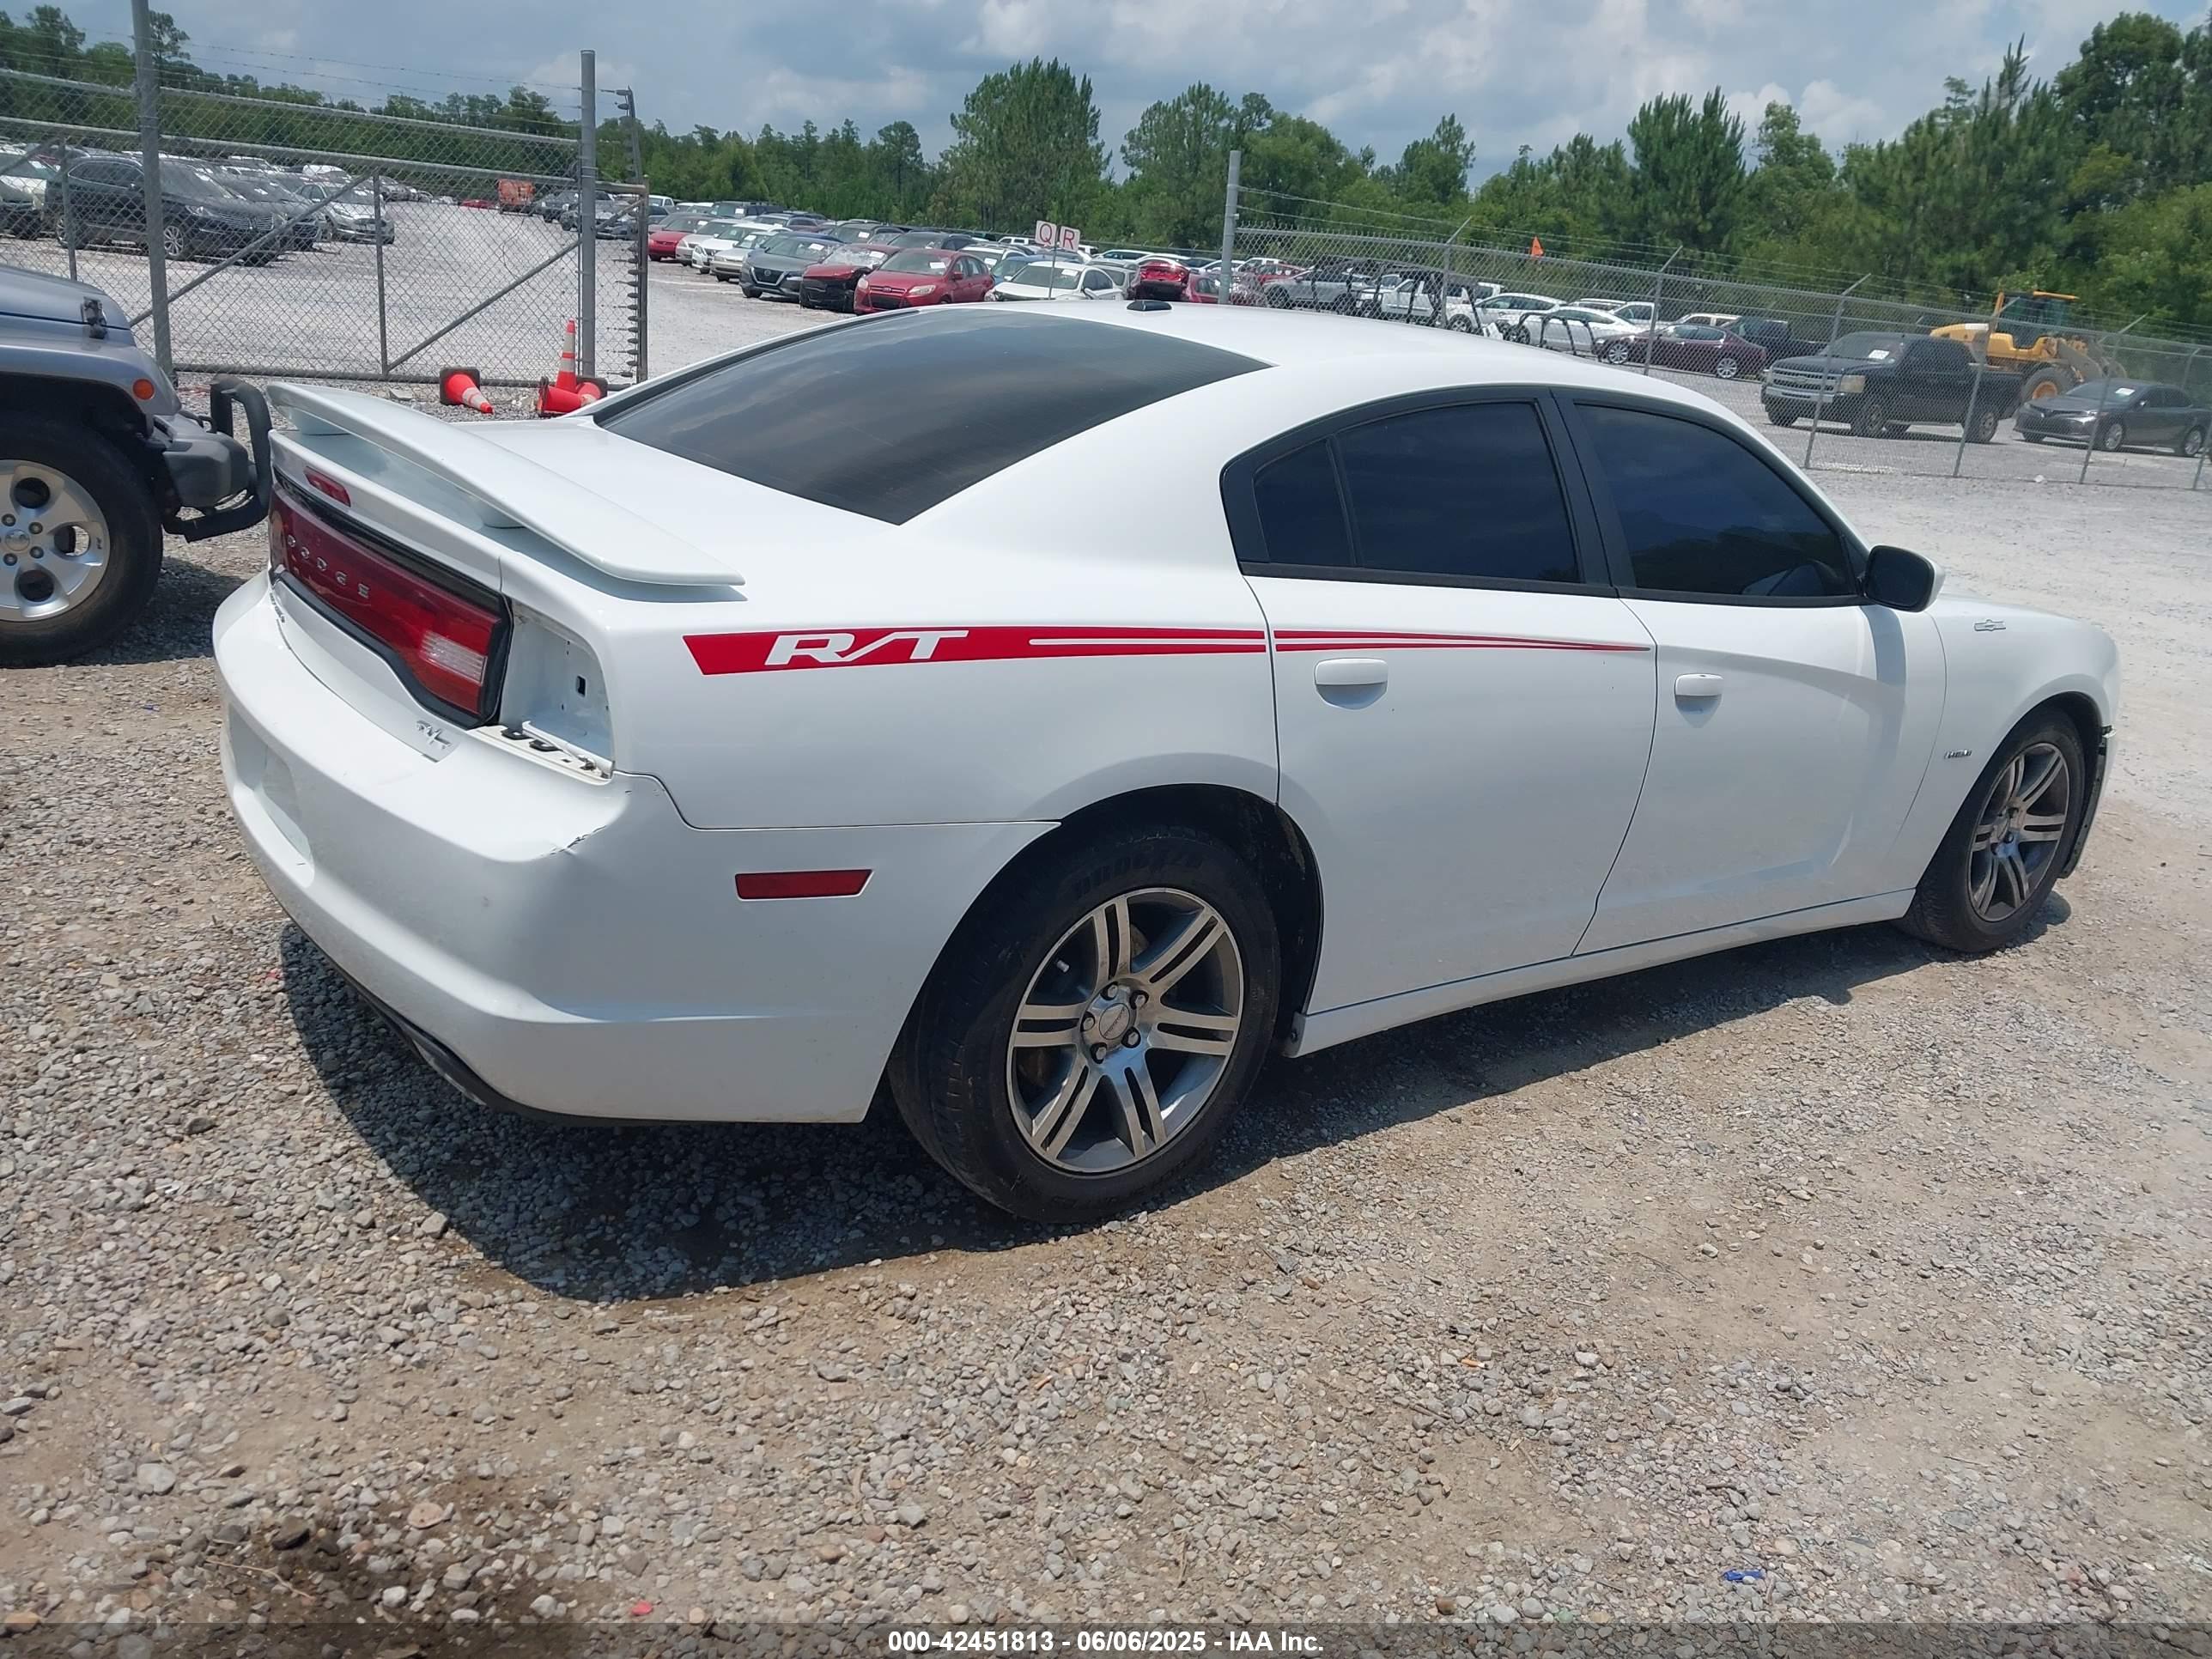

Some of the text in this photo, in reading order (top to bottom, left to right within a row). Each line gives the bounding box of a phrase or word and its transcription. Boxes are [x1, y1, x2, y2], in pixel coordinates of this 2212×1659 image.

[1039, 223, 1053, 246] Q
[1062, 228, 1075, 250] R
[288, 533, 370, 599] DODGE
[763, 629, 969, 665] R/T
